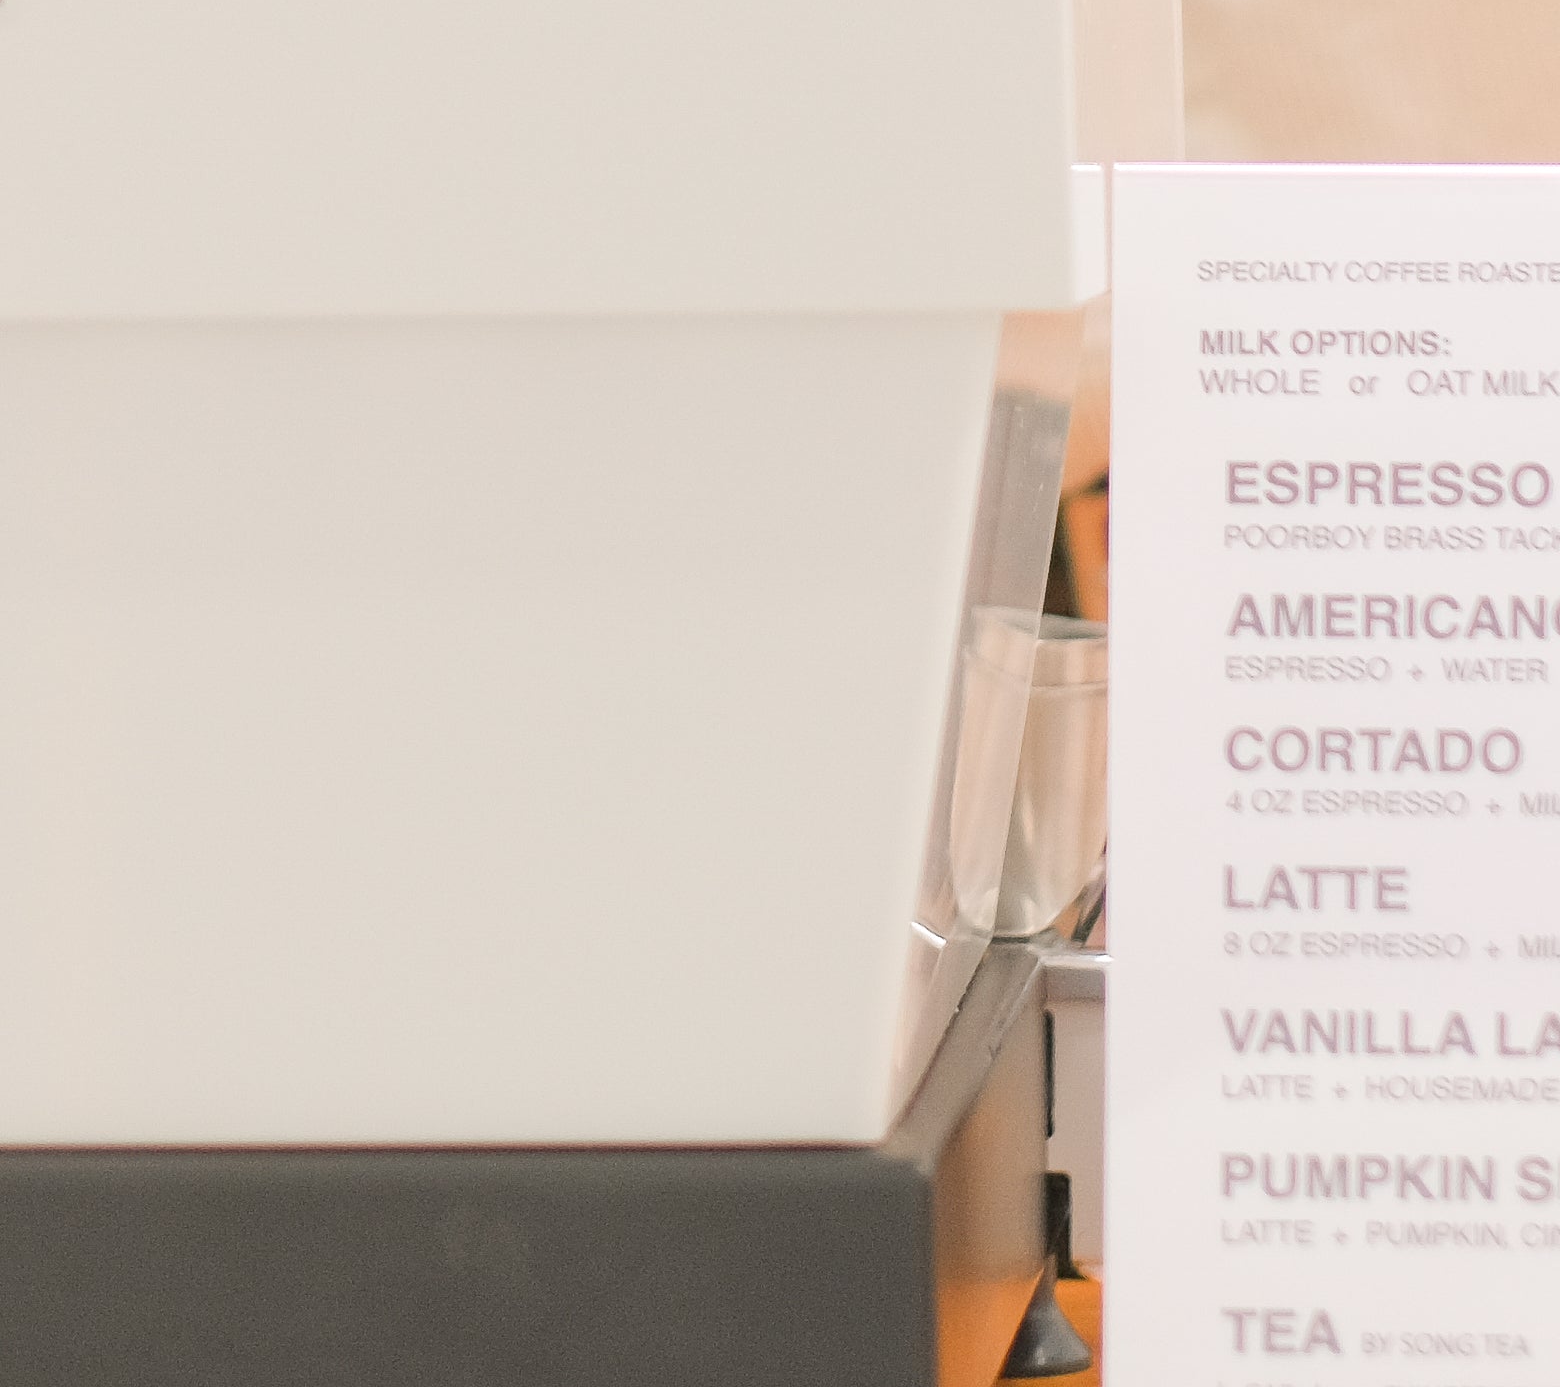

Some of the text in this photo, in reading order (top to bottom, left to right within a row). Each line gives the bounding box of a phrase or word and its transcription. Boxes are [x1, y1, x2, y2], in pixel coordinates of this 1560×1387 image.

[1197, 259, 1338, 283] SPECIALTY
[1344, 260, 1451, 284] COFFEE
[1200, 329, 1450, 358] MILK OPTIONS:
[1198, 368, 1560, 398] WHOLE or OAT MILK
[1226, 460, 1552, 509] ESPRESSO
[1223, 523, 1374, 551] POORBOY
[1383, 525, 1486, 552] BRASS
[1224, 654, 1392, 682] ESPRESSO
[1441, 657, 1549, 684] WATER
[1224, 726, 1523, 776] CORTADO
[1225, 791, 1244, 814] 4
[1250, 788, 1294, 816] OZ
[1302, 789, 1470, 817] ESPRESSO
[1223, 865, 1409, 913] LATTE
[1223, 931, 1243, 958] 8
[1248, 931, 1292, 959] OZ
[1300, 932, 1470, 960] ESPRESSO
[1221, 1009, 1478, 1057] VANILLA
[1221, 1073, 1313, 1101] LATTE
[1365, 1075, 1560, 1104] HOUSEMADE
[1221, 1153, 1496, 1202] PUMPKIN
[1221, 1219, 1312, 1247] LATTE
[1222, 1308, 1532, 1359] TEA BY SONG TEA
